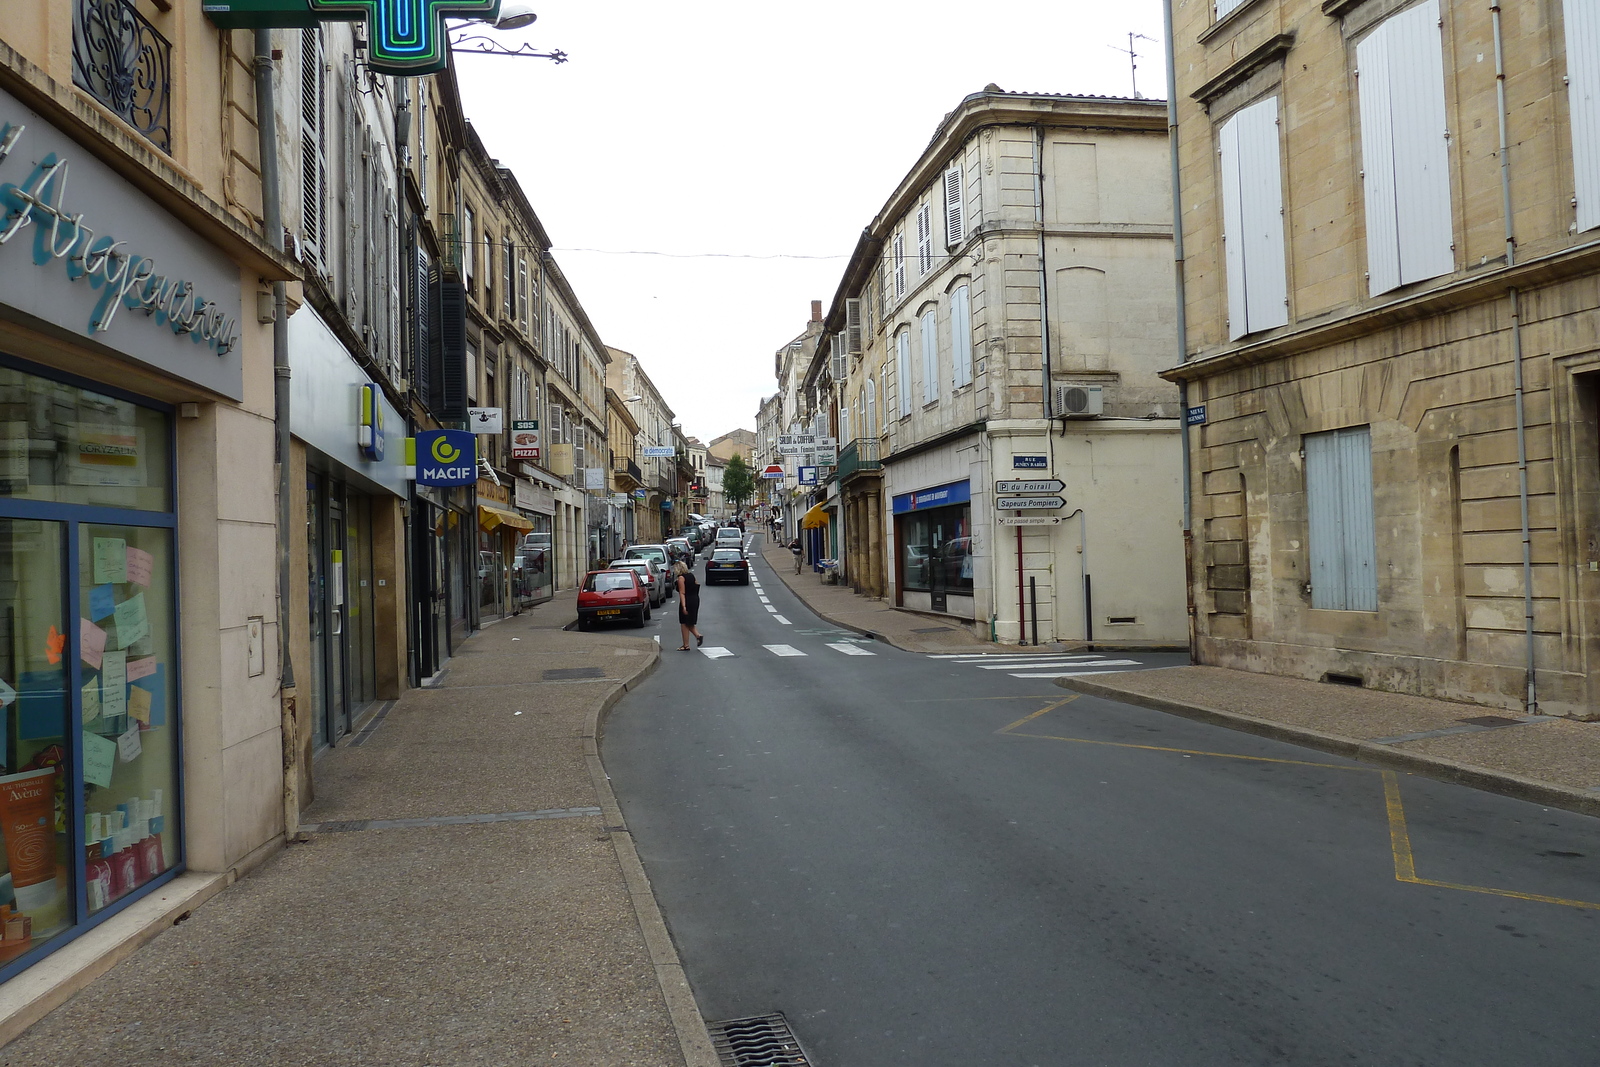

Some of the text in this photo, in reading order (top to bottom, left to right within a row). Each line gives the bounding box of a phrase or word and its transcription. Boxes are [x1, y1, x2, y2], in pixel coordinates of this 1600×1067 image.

[780, 436, 792, 444] SALON
[78, 444, 138, 456] CORYZALIA
[423, 467, 471, 480] MACIF
[1001, 500, 1058, 508] Sapeurs Pompiers
[9, 788, 42, 802] Avène
